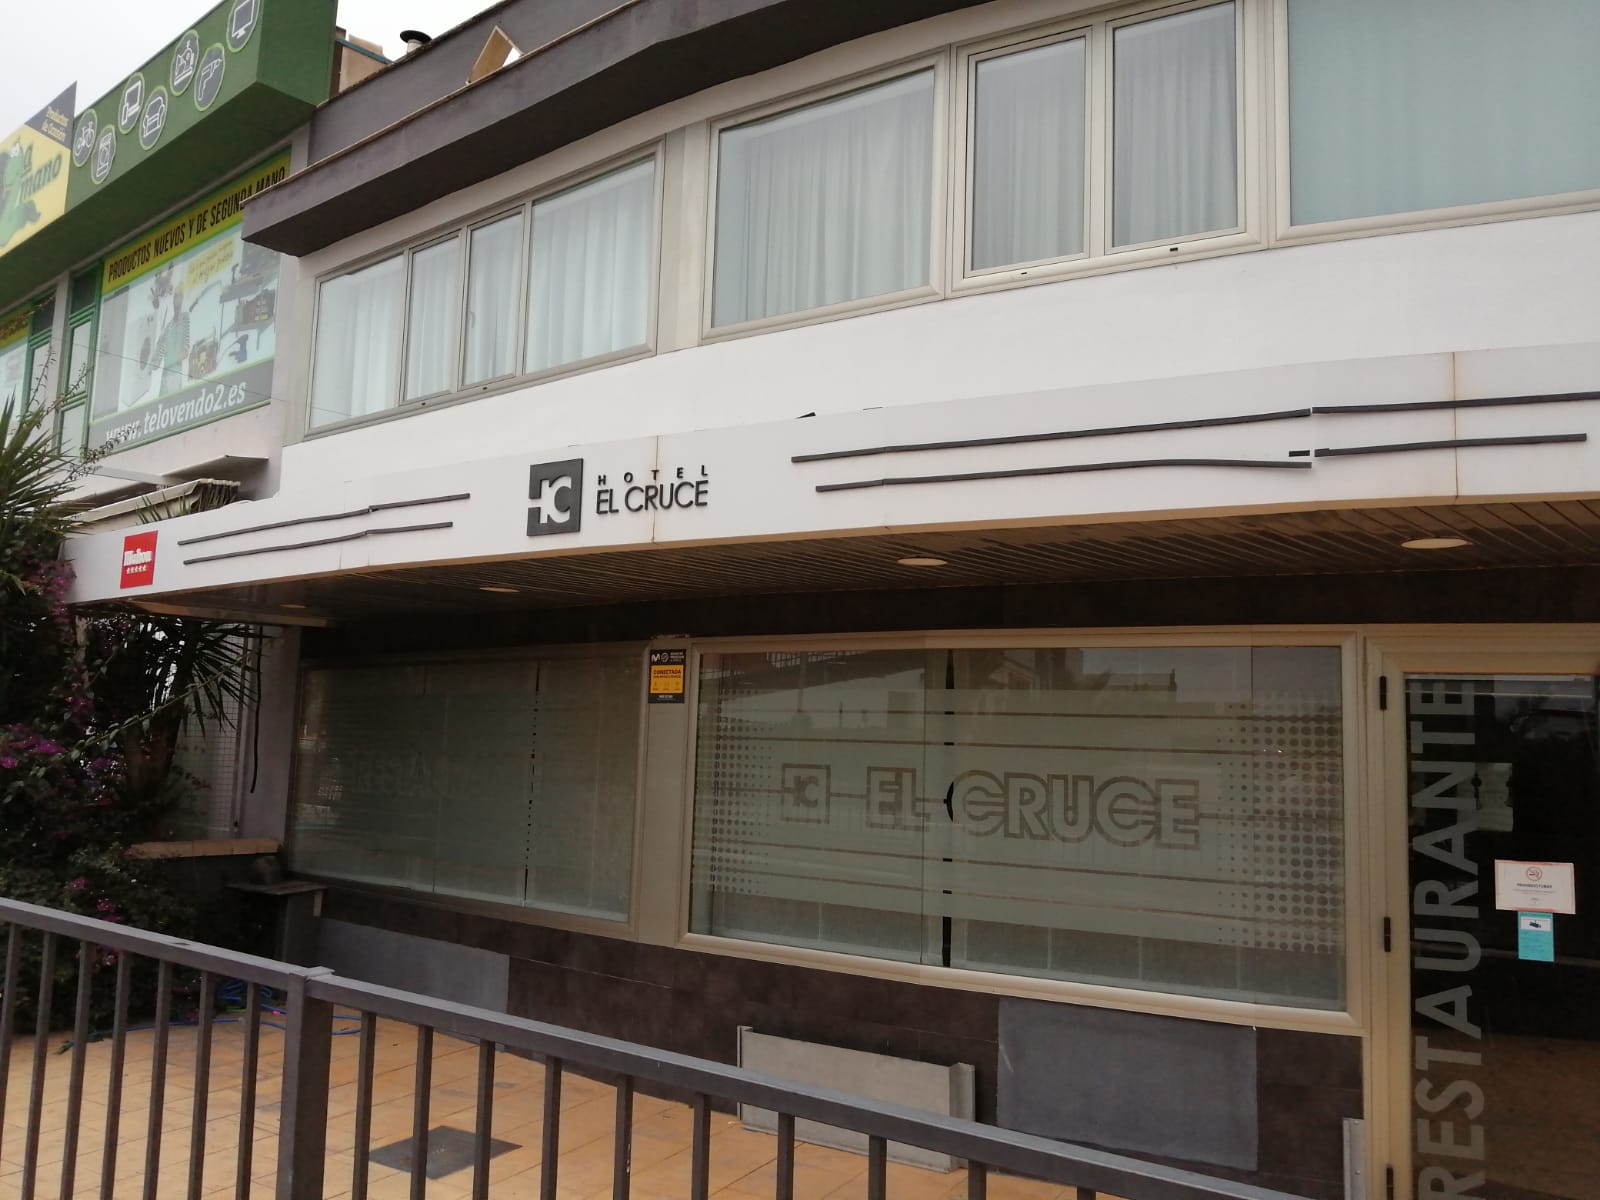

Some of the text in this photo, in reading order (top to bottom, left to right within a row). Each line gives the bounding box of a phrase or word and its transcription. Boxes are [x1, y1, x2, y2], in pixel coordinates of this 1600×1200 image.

[108, 242, 151, 283] PRODUCTOS
[154, 223, 185, 257] NUEVOS
[188, 217, 195, 239] Y
[196, 210, 208, 235] DE
[596, 488, 619, 515] EL
[624, 480, 709, 513] CRUCE
[597, 465, 708, 486] HOTEL
[866, 766, 930, 831] EL
[945, 769, 1200, 849] CRUCE
[1408, 682, 1486, 1200] RESTAURANTE
